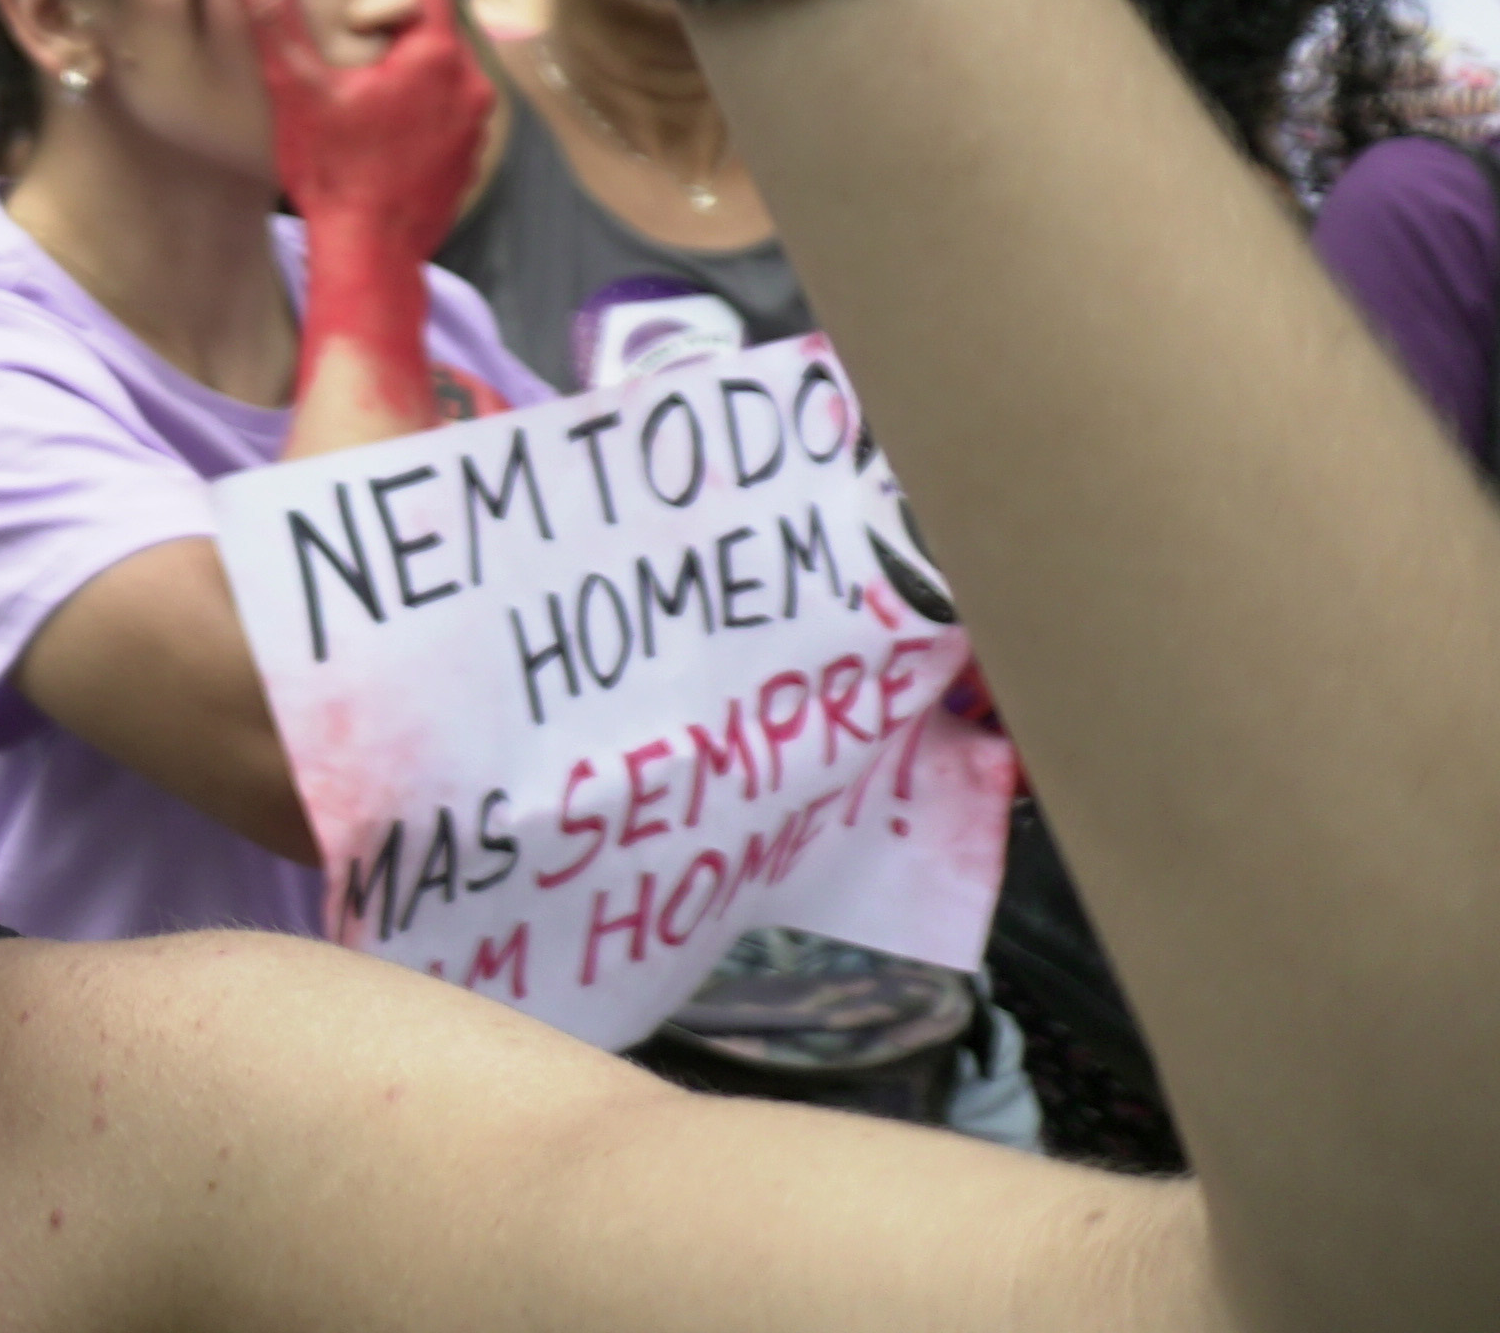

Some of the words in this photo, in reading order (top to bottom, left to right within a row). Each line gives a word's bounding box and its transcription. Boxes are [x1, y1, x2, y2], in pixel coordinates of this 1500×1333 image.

[286, 427, 554, 663] NEM
[565, 363, 848, 525] TODO
[338, 788, 520, 945] MAS
[536, 636, 934, 889] SEMPRE
